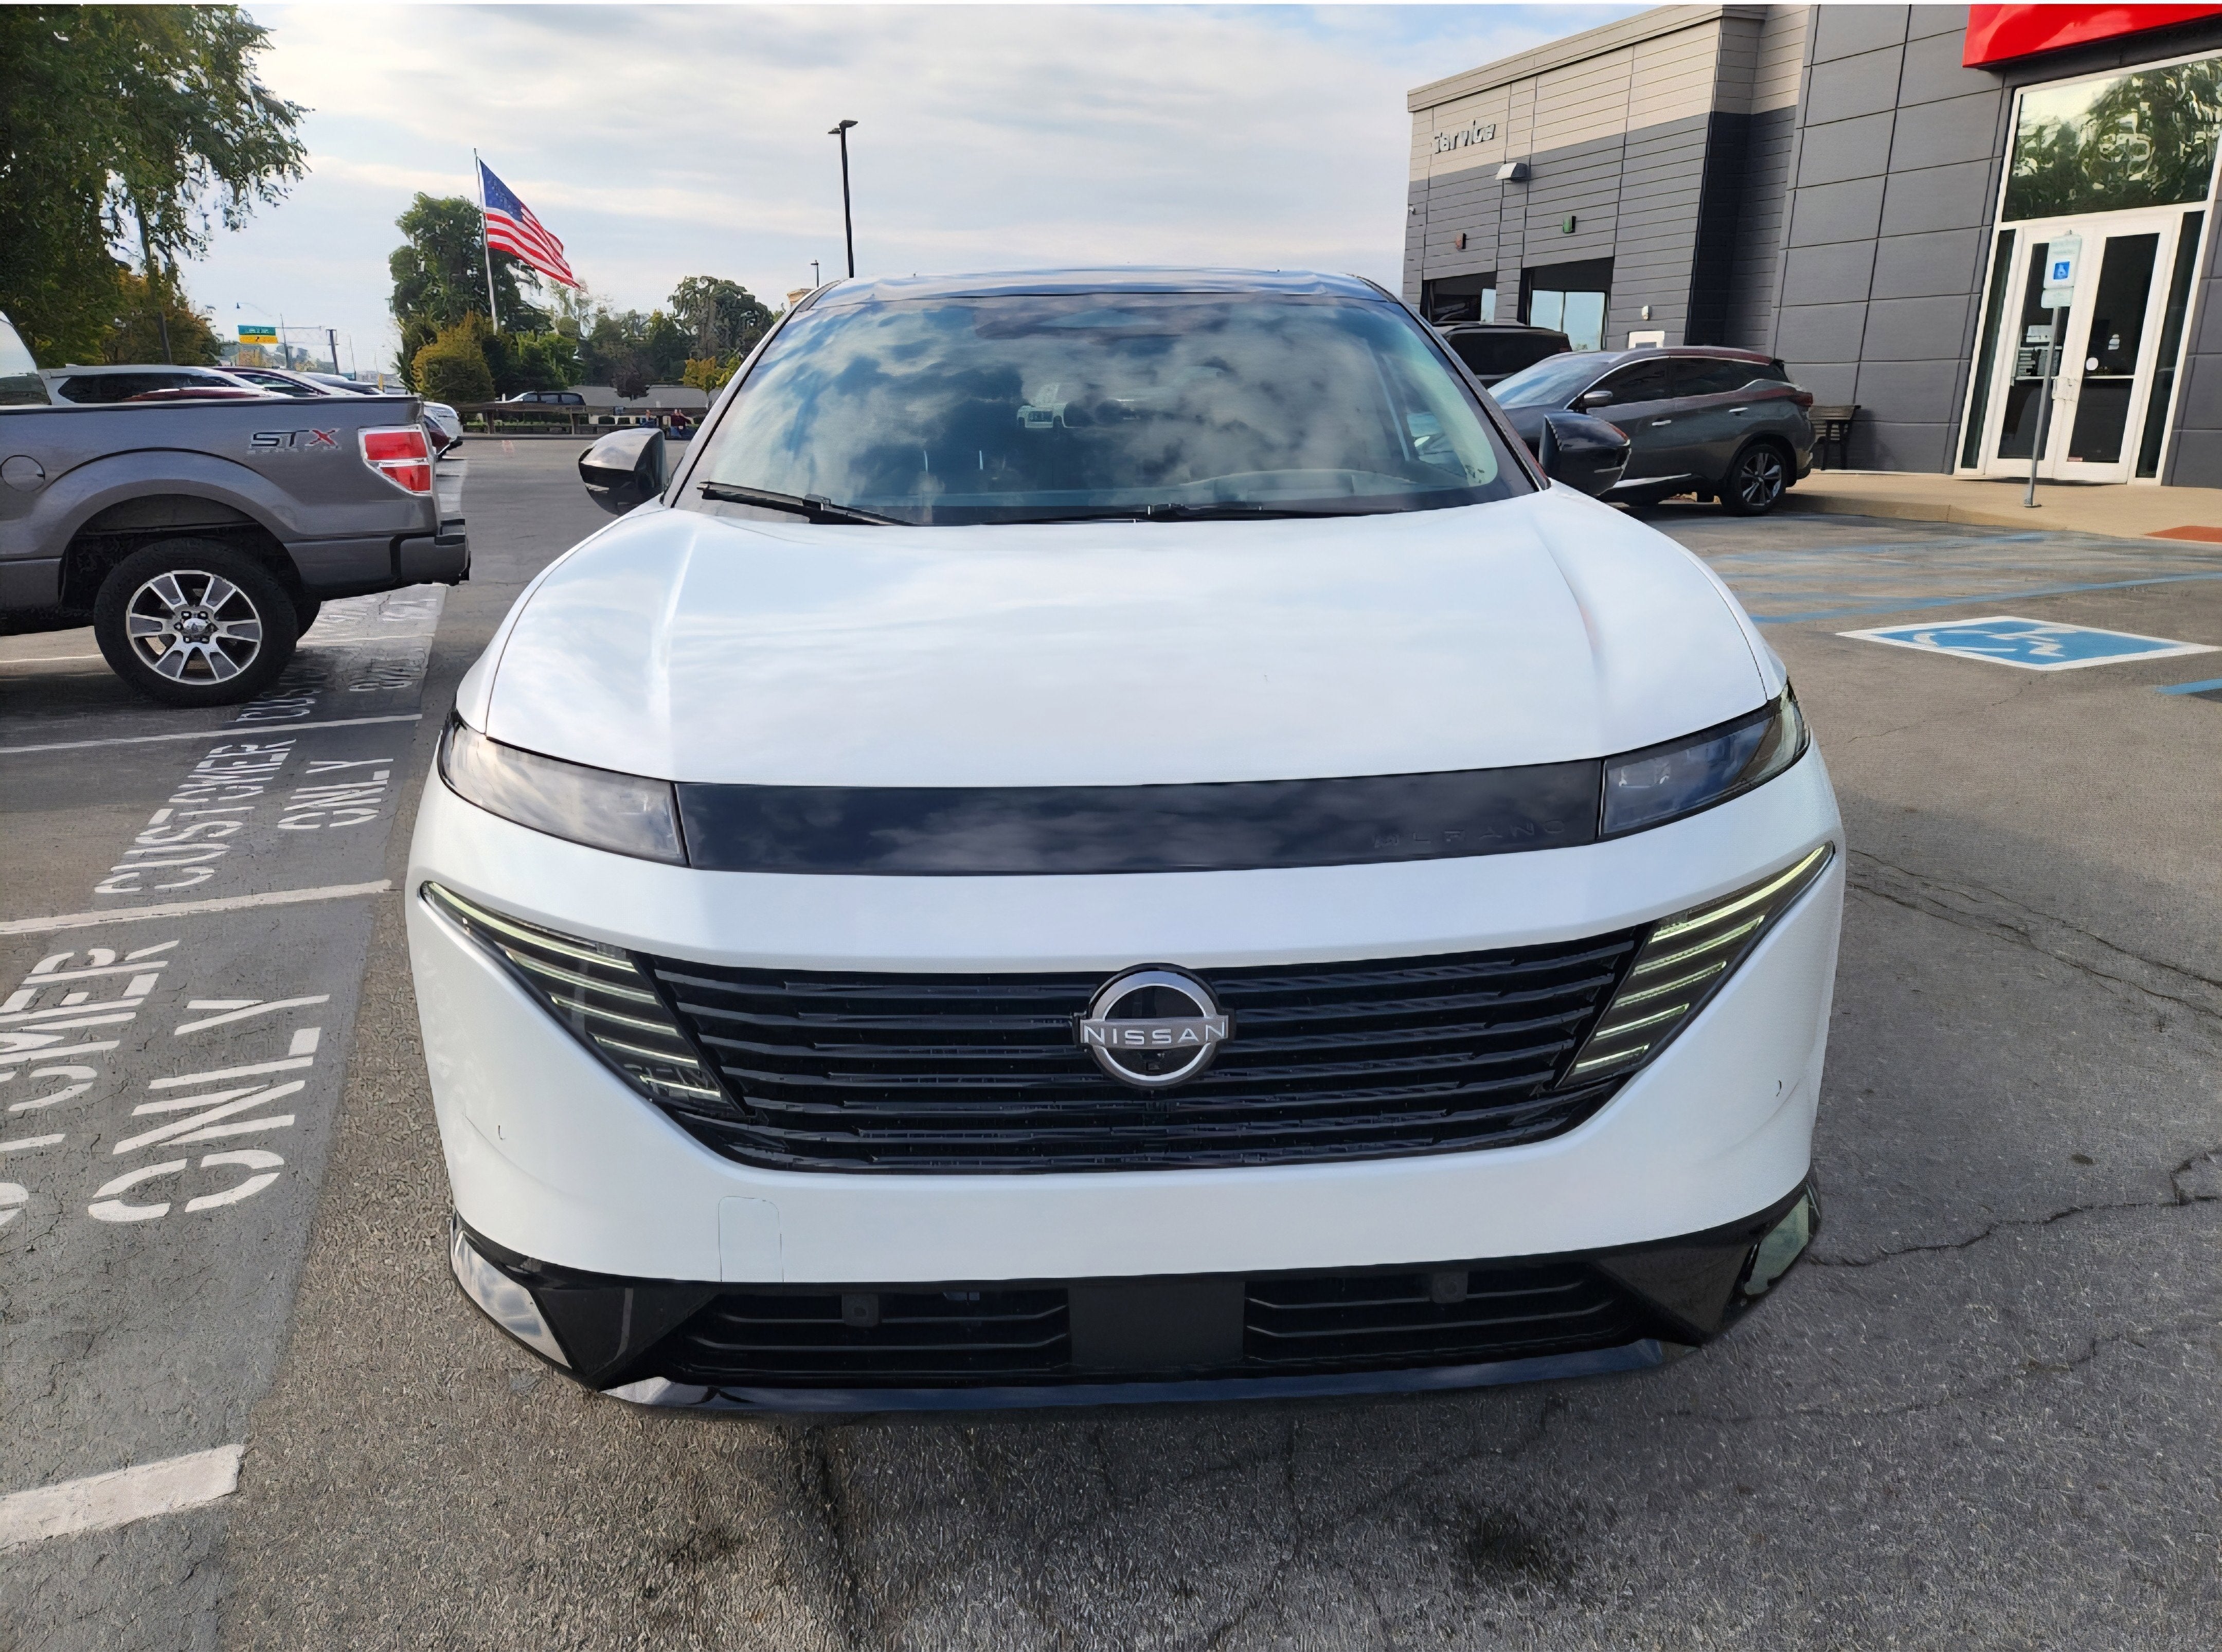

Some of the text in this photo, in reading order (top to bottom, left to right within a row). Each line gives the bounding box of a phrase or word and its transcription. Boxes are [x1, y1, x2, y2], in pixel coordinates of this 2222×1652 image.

[249, 428, 341, 453] STX
[95, 739, 297, 893] CUSTOMER
[278, 758, 395, 830] ONLY
[1083, 1021, 1225, 1046] NISSAN
[88, 994, 330, 1222] ONLY
